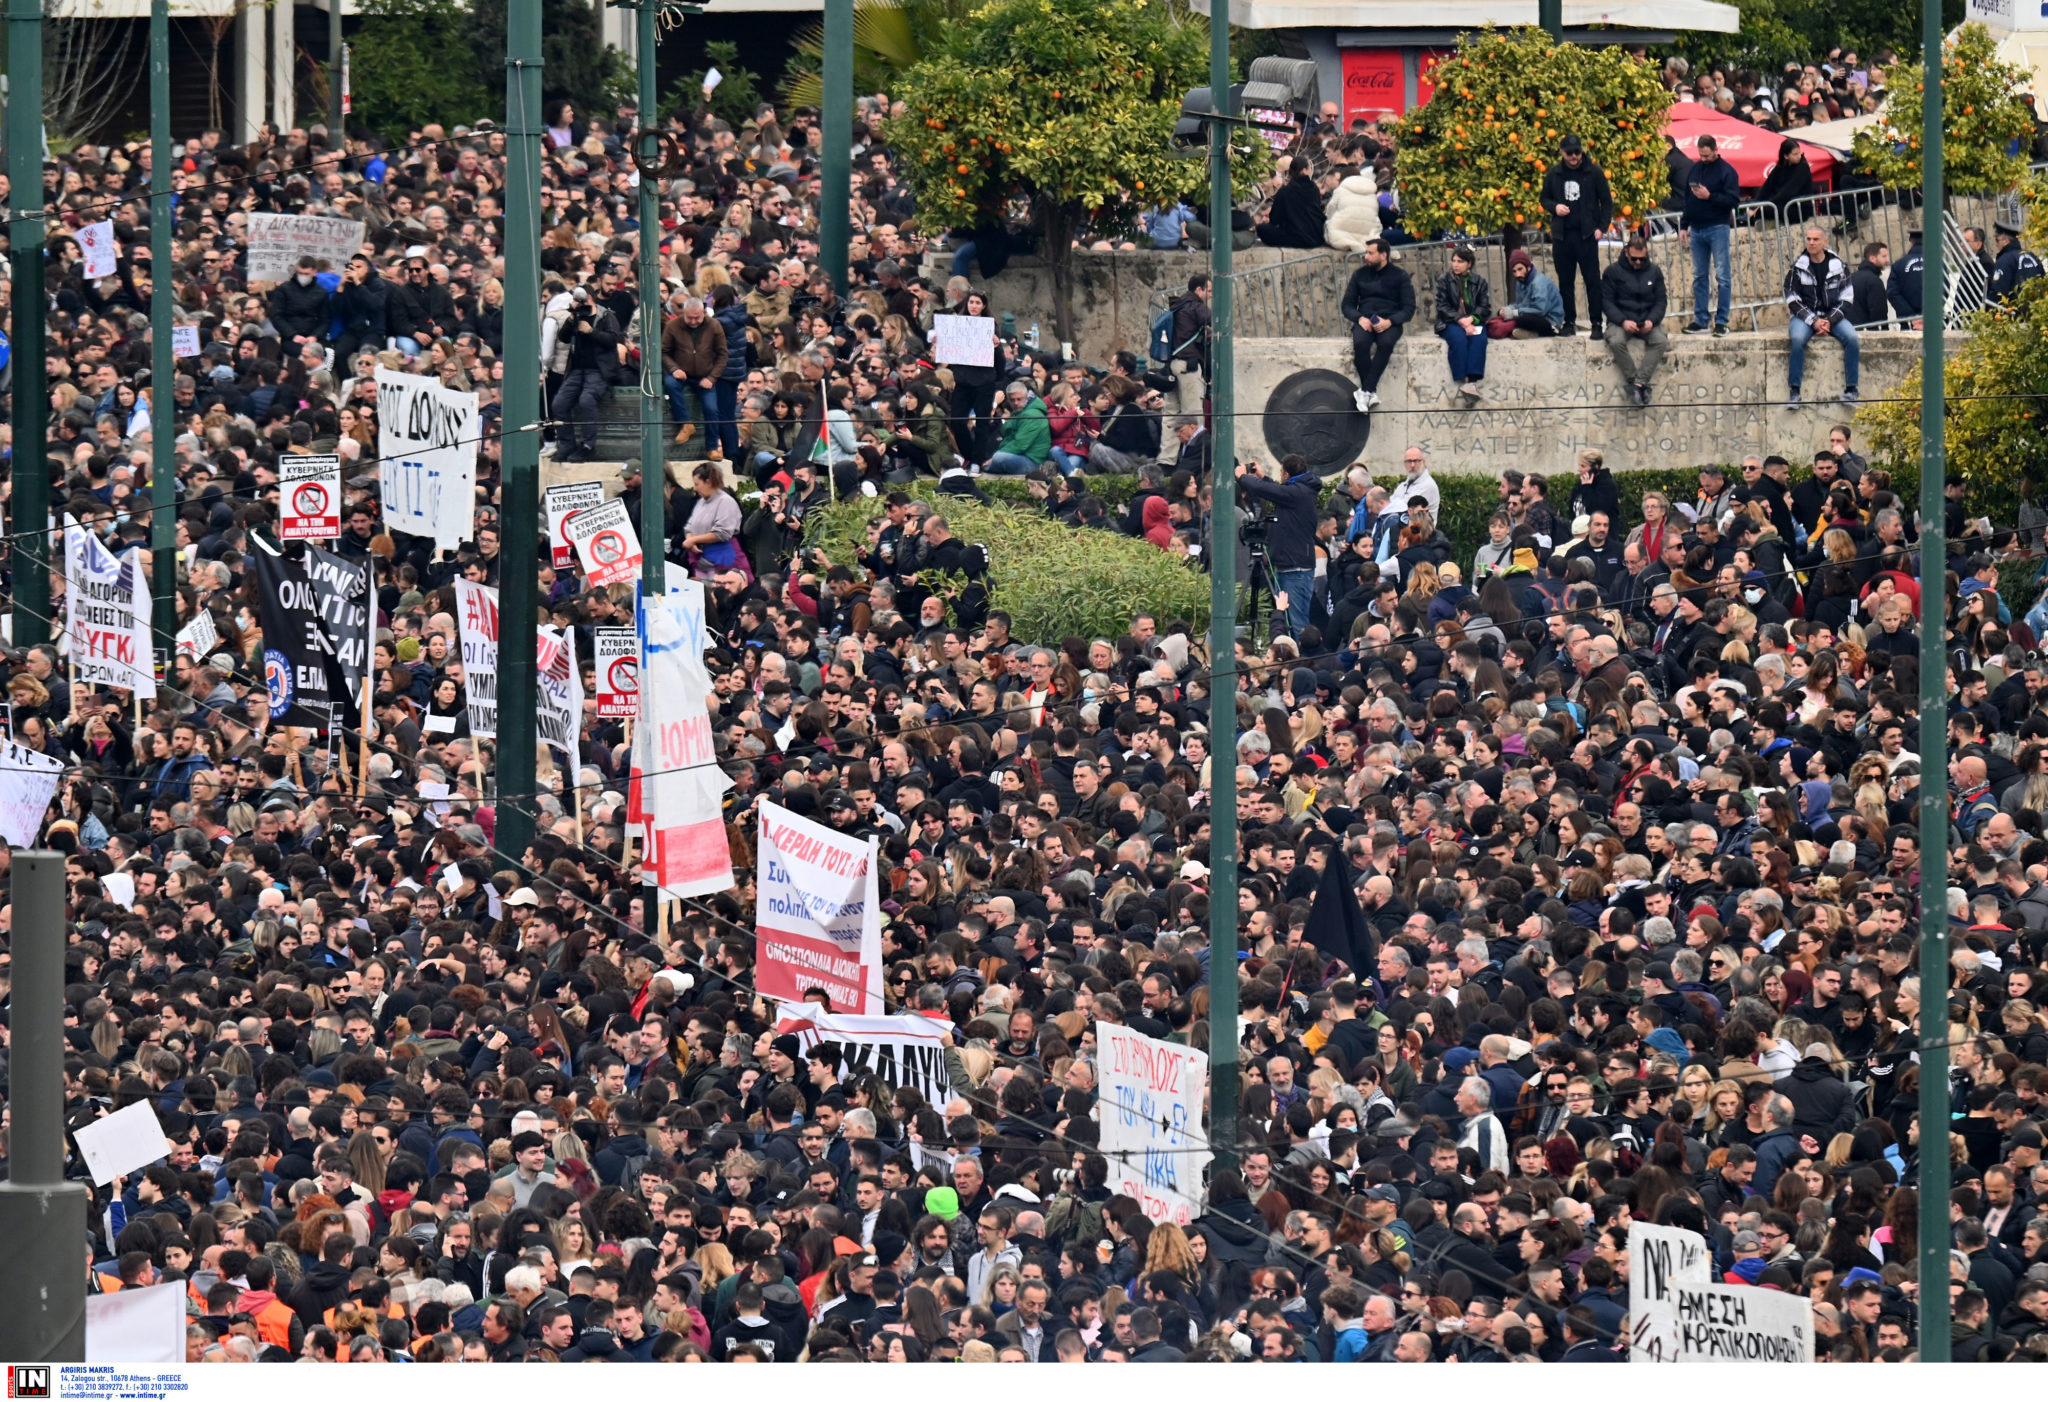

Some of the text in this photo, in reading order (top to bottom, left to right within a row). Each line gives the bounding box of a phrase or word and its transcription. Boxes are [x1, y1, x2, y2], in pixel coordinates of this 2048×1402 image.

[1346, 71, 1395, 89] Coca-Cola
[286, 465, 334, 474] ΚΥΒΕΡΝΗΣΗ
[285, 473, 336, 482] ΔΟΛΟΦΟΝΩΝ
[552, 491, 599, 503] ΚΥΒΕΡΝΗΣΗ
[551, 499, 602, 512] ΔΟΛΟΦΟΝΩΝ
[297, 518, 325, 527] ΝΑ ΤΗΝ
[575, 509, 621, 531] ΚΥΒΕΡΝΗΣΗ
[284, 526, 338, 537] ΑΝΑΤΡΕΨΟΥΜΕ
[576, 515, 626, 540] ΔΟΛΟΦΟΝΩΝ
[602, 566, 614, 576] ΝΑ
[601, 639, 635, 647] ΚΥΒΕΡΝ
[599, 647, 636, 656] ΔΟΛΟΦΟ
[613, 695, 637, 704] ΝΑ ΤΗ
[600, 705, 636, 715] ΑΝΑΤΡΕΨ
[773, 824, 820, 866] ΚΕΡΔΗ
[820, 845, 850, 877] ΤΟΥΣ
[765, 942, 832, 976] ΟΜΟΣΠΟΝΔΙΑ
[1678, 1289, 1747, 1327] ΑΜΕΣΗ
